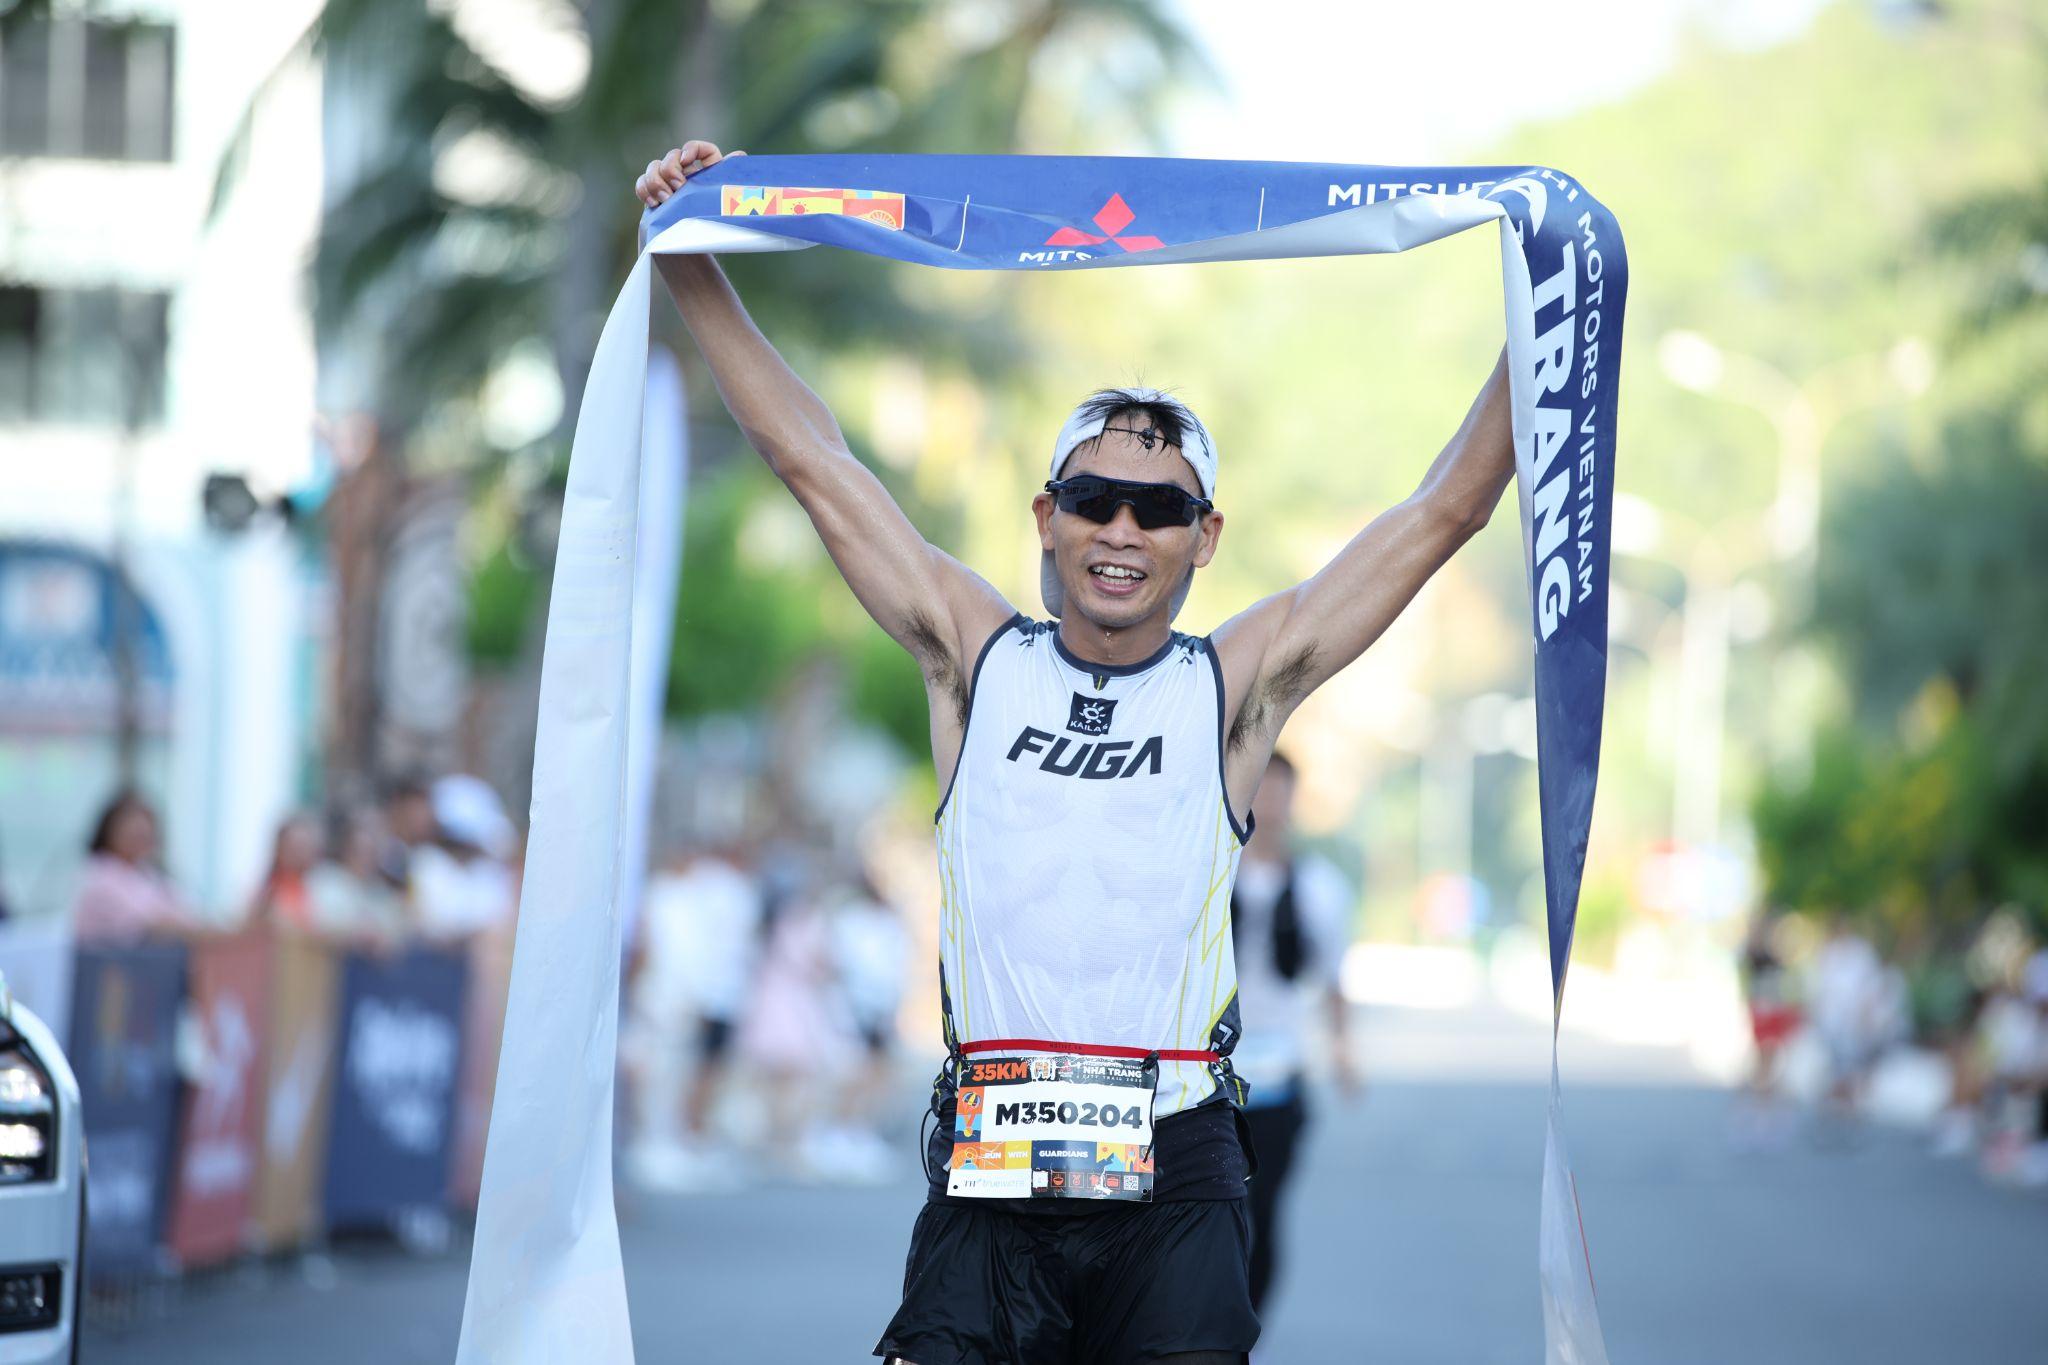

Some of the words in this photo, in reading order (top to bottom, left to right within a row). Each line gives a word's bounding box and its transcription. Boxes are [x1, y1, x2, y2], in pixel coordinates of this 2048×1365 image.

[1577, 211, 1604, 399] MOTORS
[1533, 240, 1576, 642] TRANG
[1577, 404, 1596, 604] VIETNAM
[1006, 725, 1163, 780] FUGA
[972, 1062, 1029, 1082] 35KM
[1083, 1066, 1106, 1075] NHA
[1107, 1068, 1142, 1078] TRANG
[995, 1101, 1143, 1129] M350204
[984, 1151, 1002, 1159] RUN
[1038, 1150, 1089, 1159] GUARDIANS
